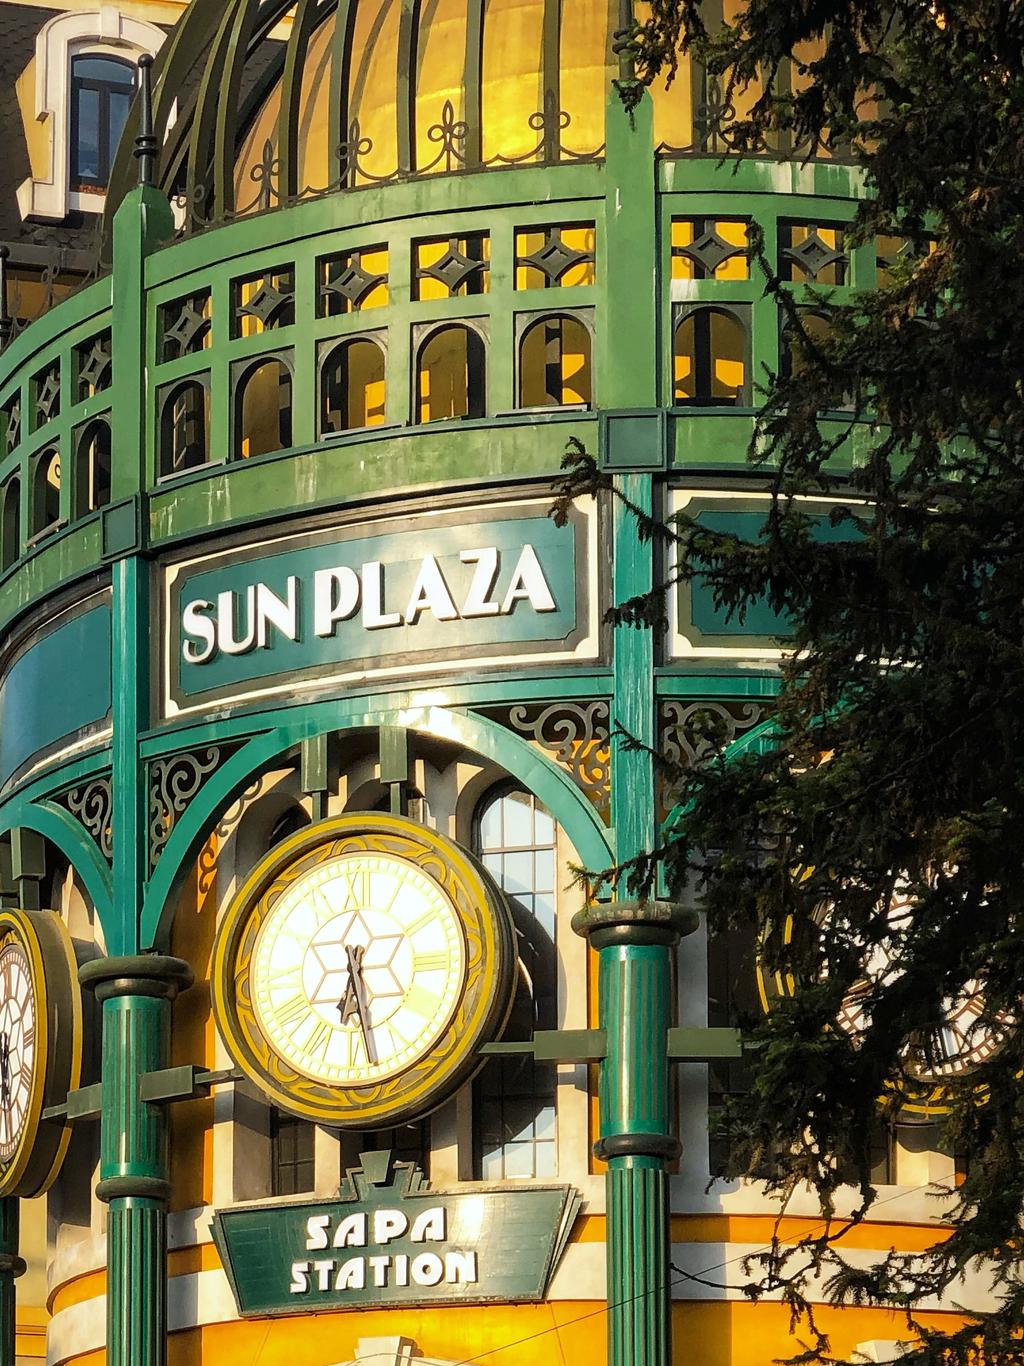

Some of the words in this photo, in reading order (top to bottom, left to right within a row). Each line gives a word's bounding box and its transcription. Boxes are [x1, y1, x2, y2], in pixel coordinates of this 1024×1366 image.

[182, 575, 301, 665] SUN
[314, 543, 556, 638] PLAZA
[305, 1206, 448, 1251] SAPA
[289, 1249, 479, 1294] STATION
